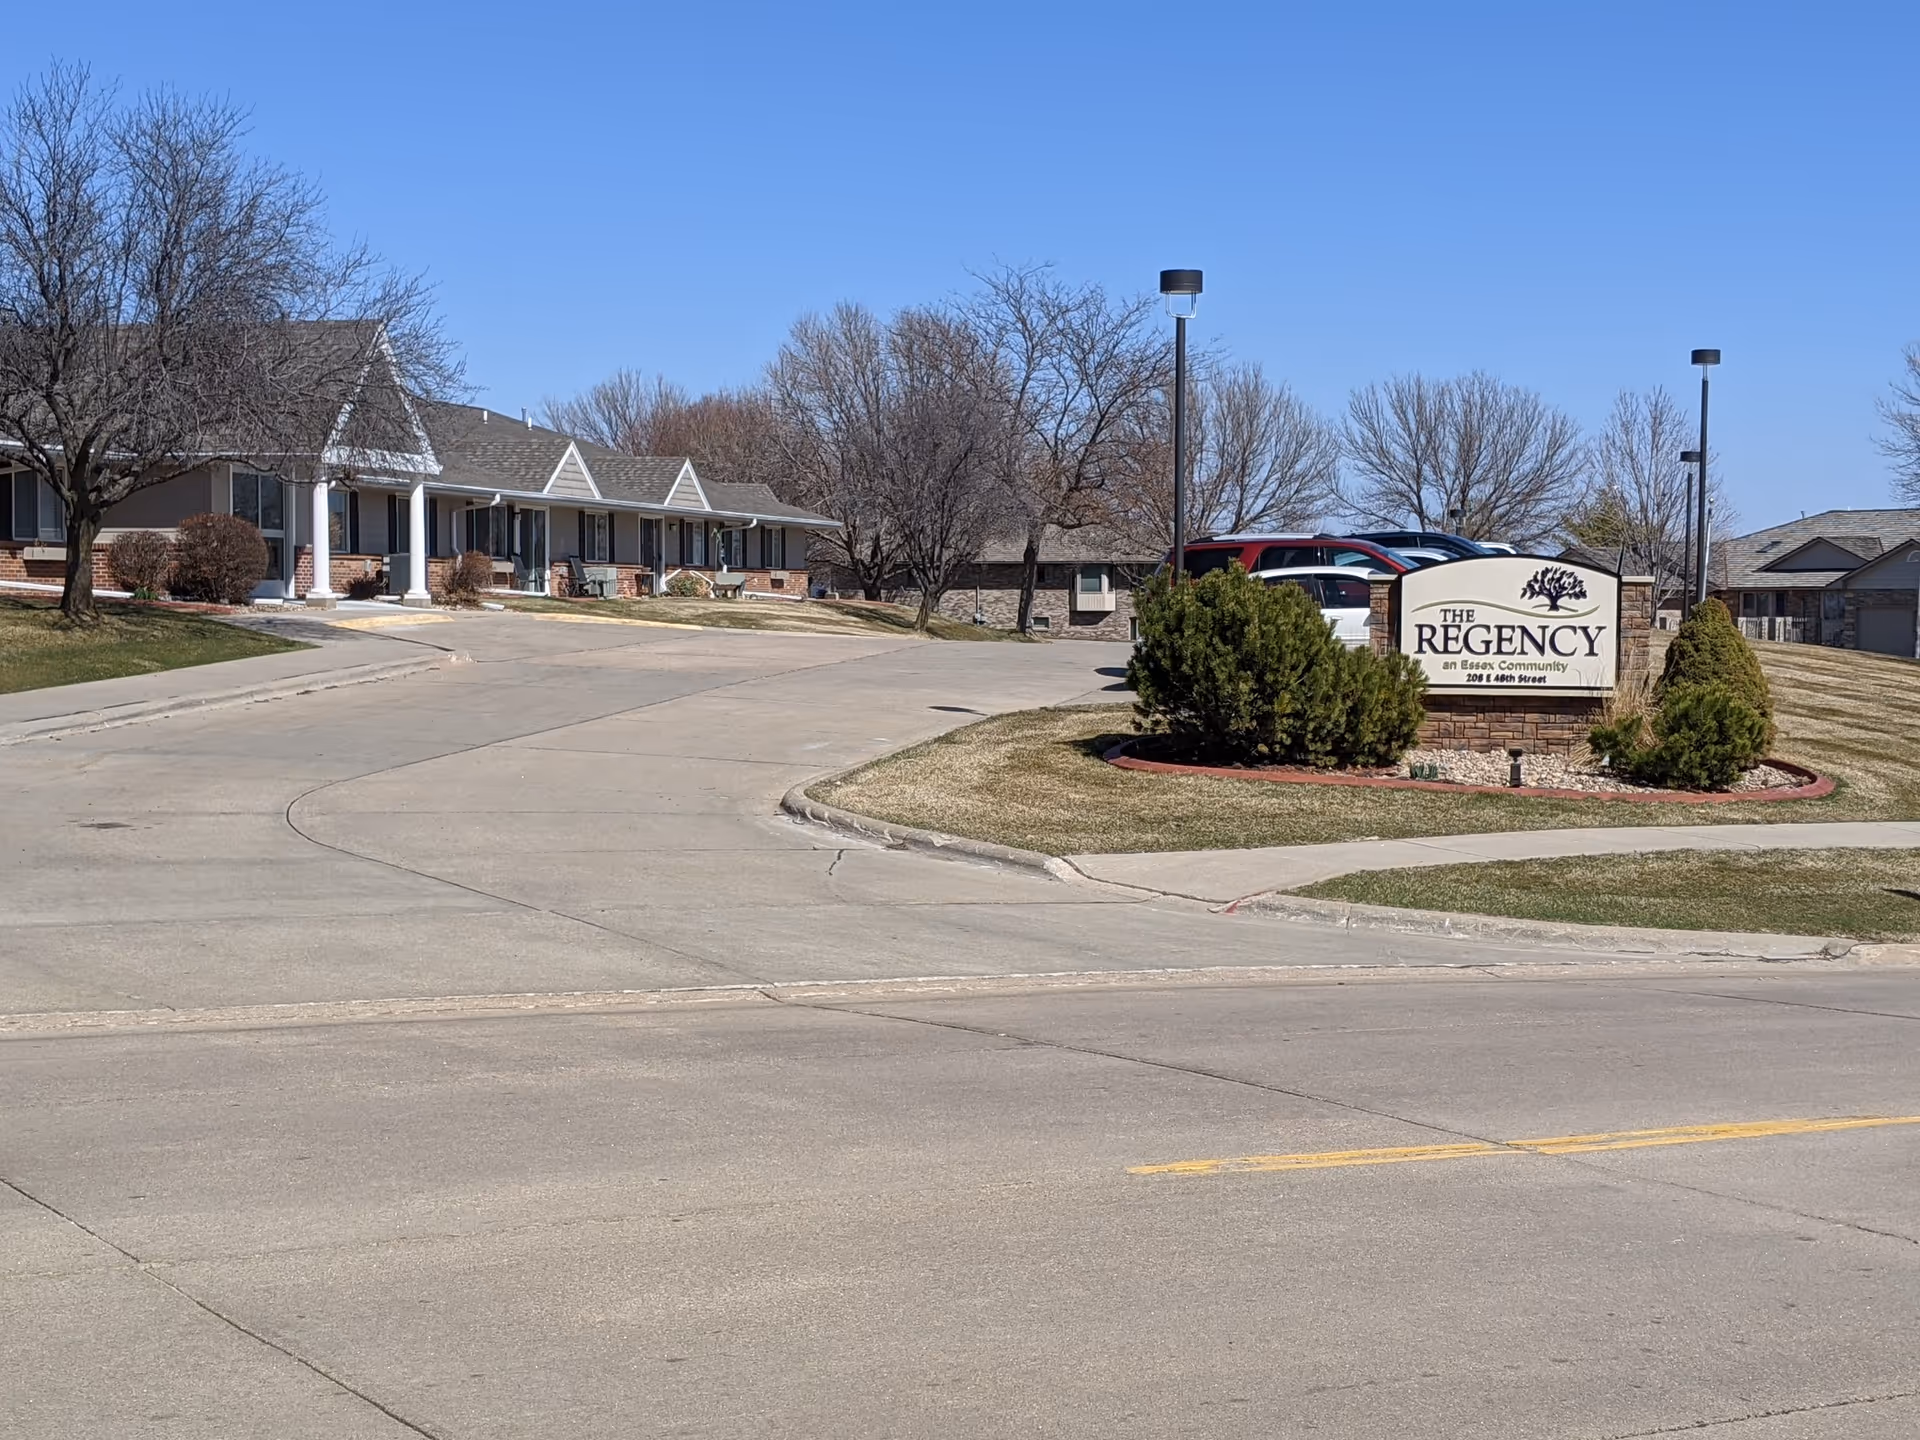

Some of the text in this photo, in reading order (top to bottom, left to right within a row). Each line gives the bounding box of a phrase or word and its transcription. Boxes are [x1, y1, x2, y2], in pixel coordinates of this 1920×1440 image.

[1440, 609, 1475, 623] THE
[1414, 624, 1607, 657] REGENCY
[1442, 660, 1568, 673] an Essex Community
[1486, 673, 1492, 683] E
[1517, 674, 1547, 684] Street
